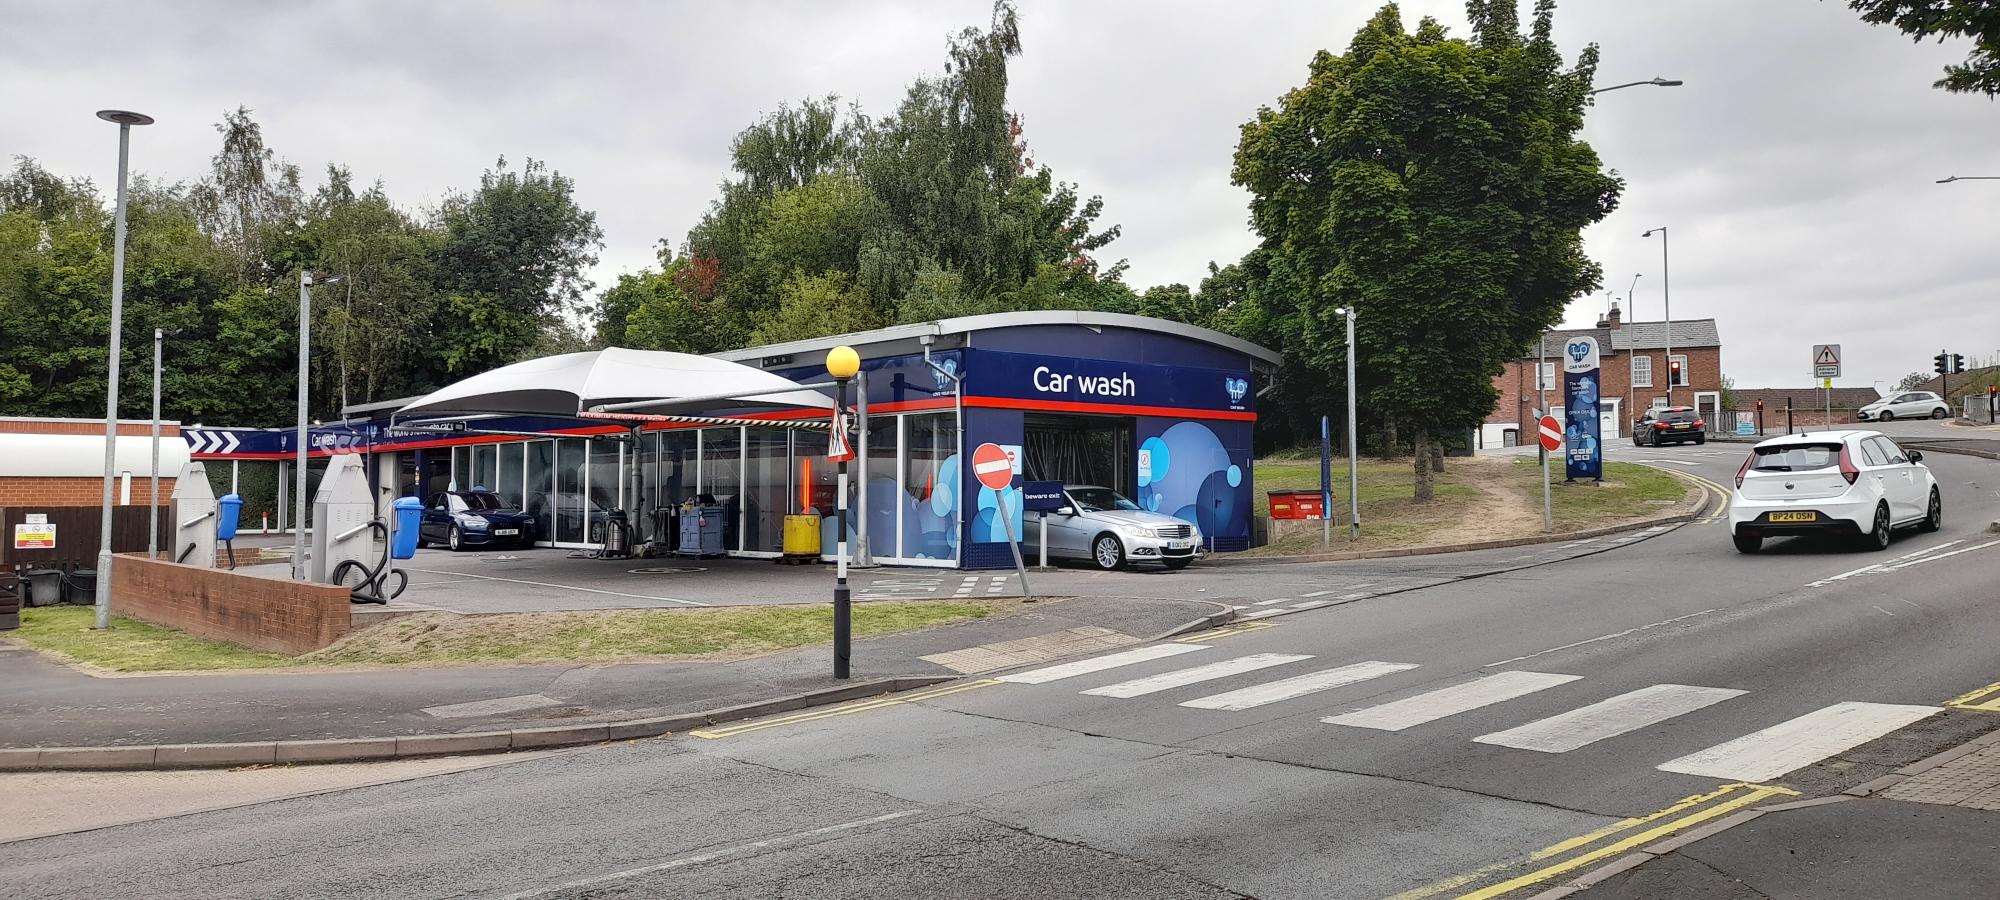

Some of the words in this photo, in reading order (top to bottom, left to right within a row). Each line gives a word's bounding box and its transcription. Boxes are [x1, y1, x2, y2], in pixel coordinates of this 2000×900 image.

[1033, 366, 1073, 393] Car
[1077, 371, 1135, 396] wash
[312, 434, 321, 447] Car
[321, 431, 337, 446] wash
[383, 427, 393, 438] The
[1772, 512, 1794, 520] BP24
[1796, 511, 1813, 520] OSN
